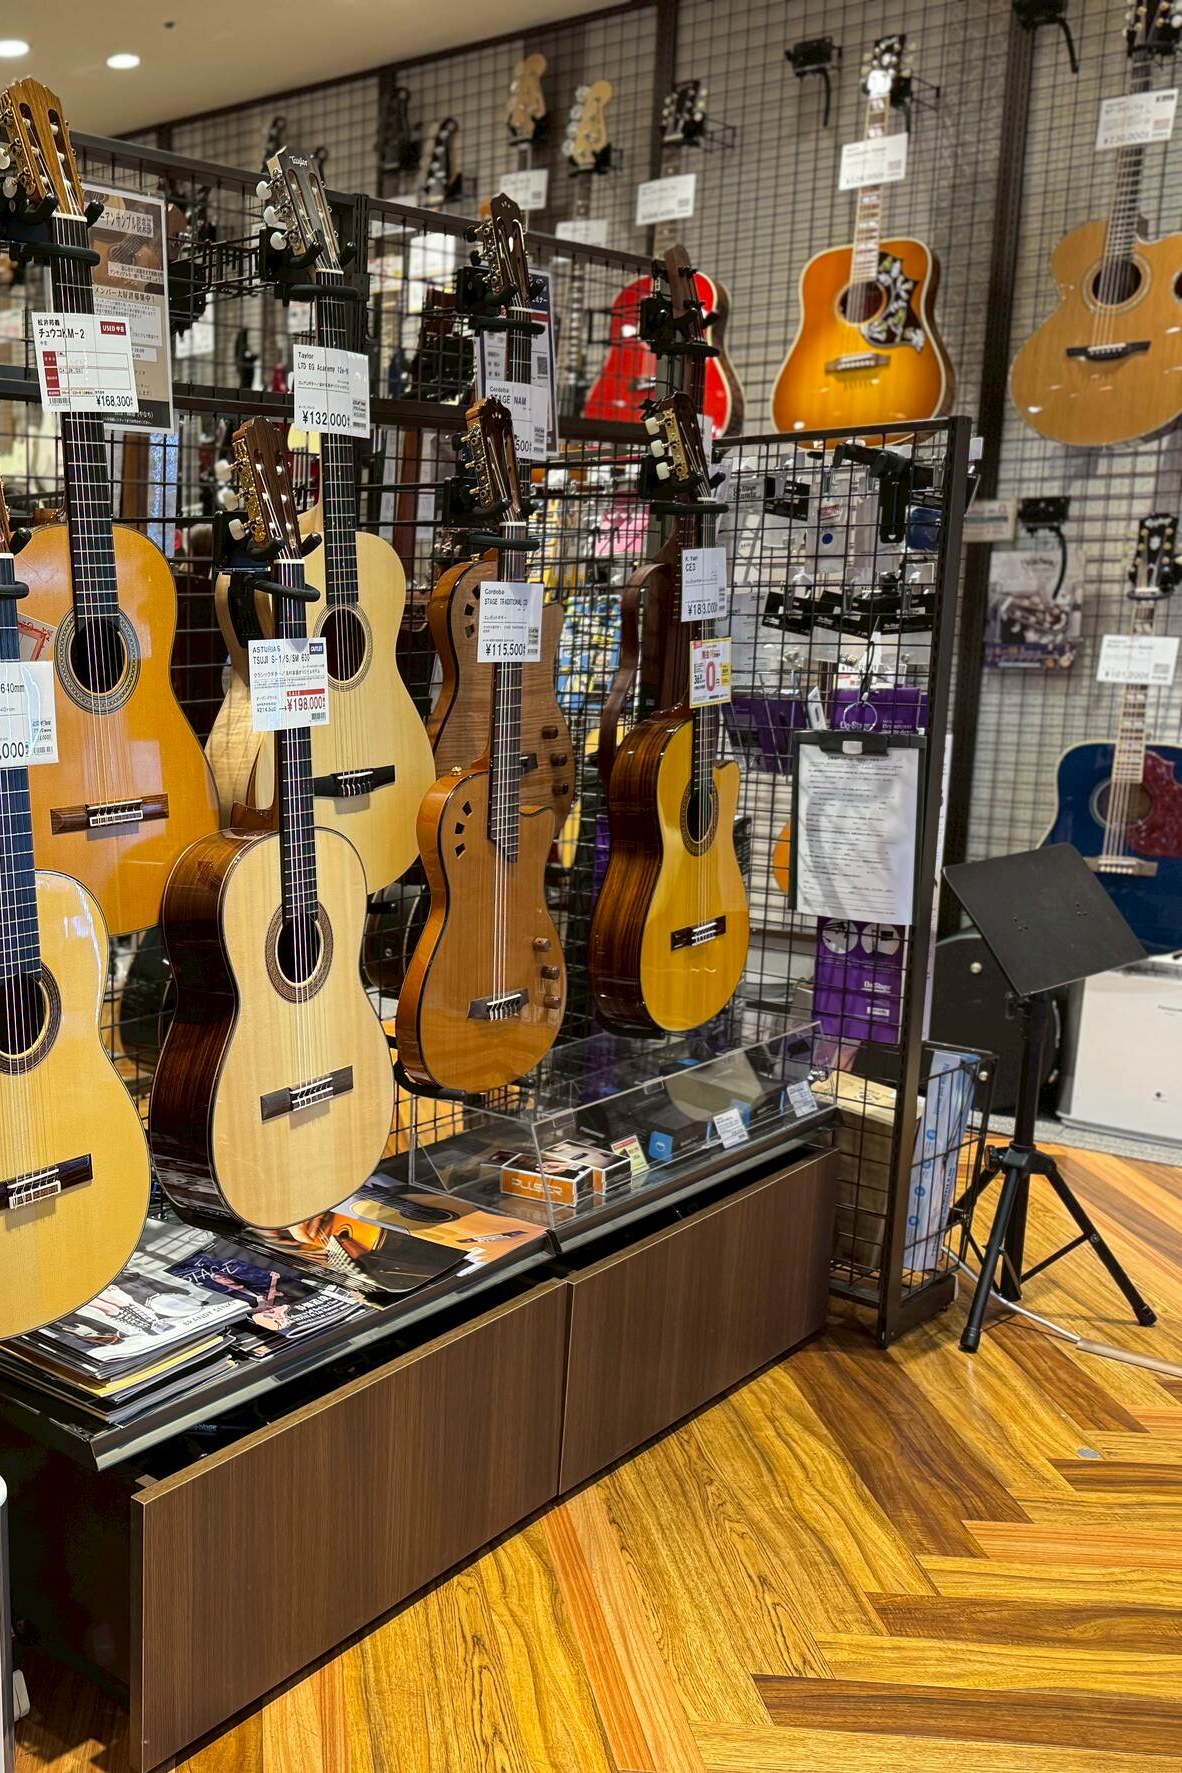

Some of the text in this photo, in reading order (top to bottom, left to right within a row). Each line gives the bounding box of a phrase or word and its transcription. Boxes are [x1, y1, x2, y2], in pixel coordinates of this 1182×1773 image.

[298, 351, 314, 360] Taylor
[96, 395, 131, 408] ¥168,300
[302, 410, 347, 427] ¥132000
[253, 645, 281, 653] ASTURIAS
[486, 643, 523, 656] ¥115,500
[287, 697, 322, 711] ¥198,000
